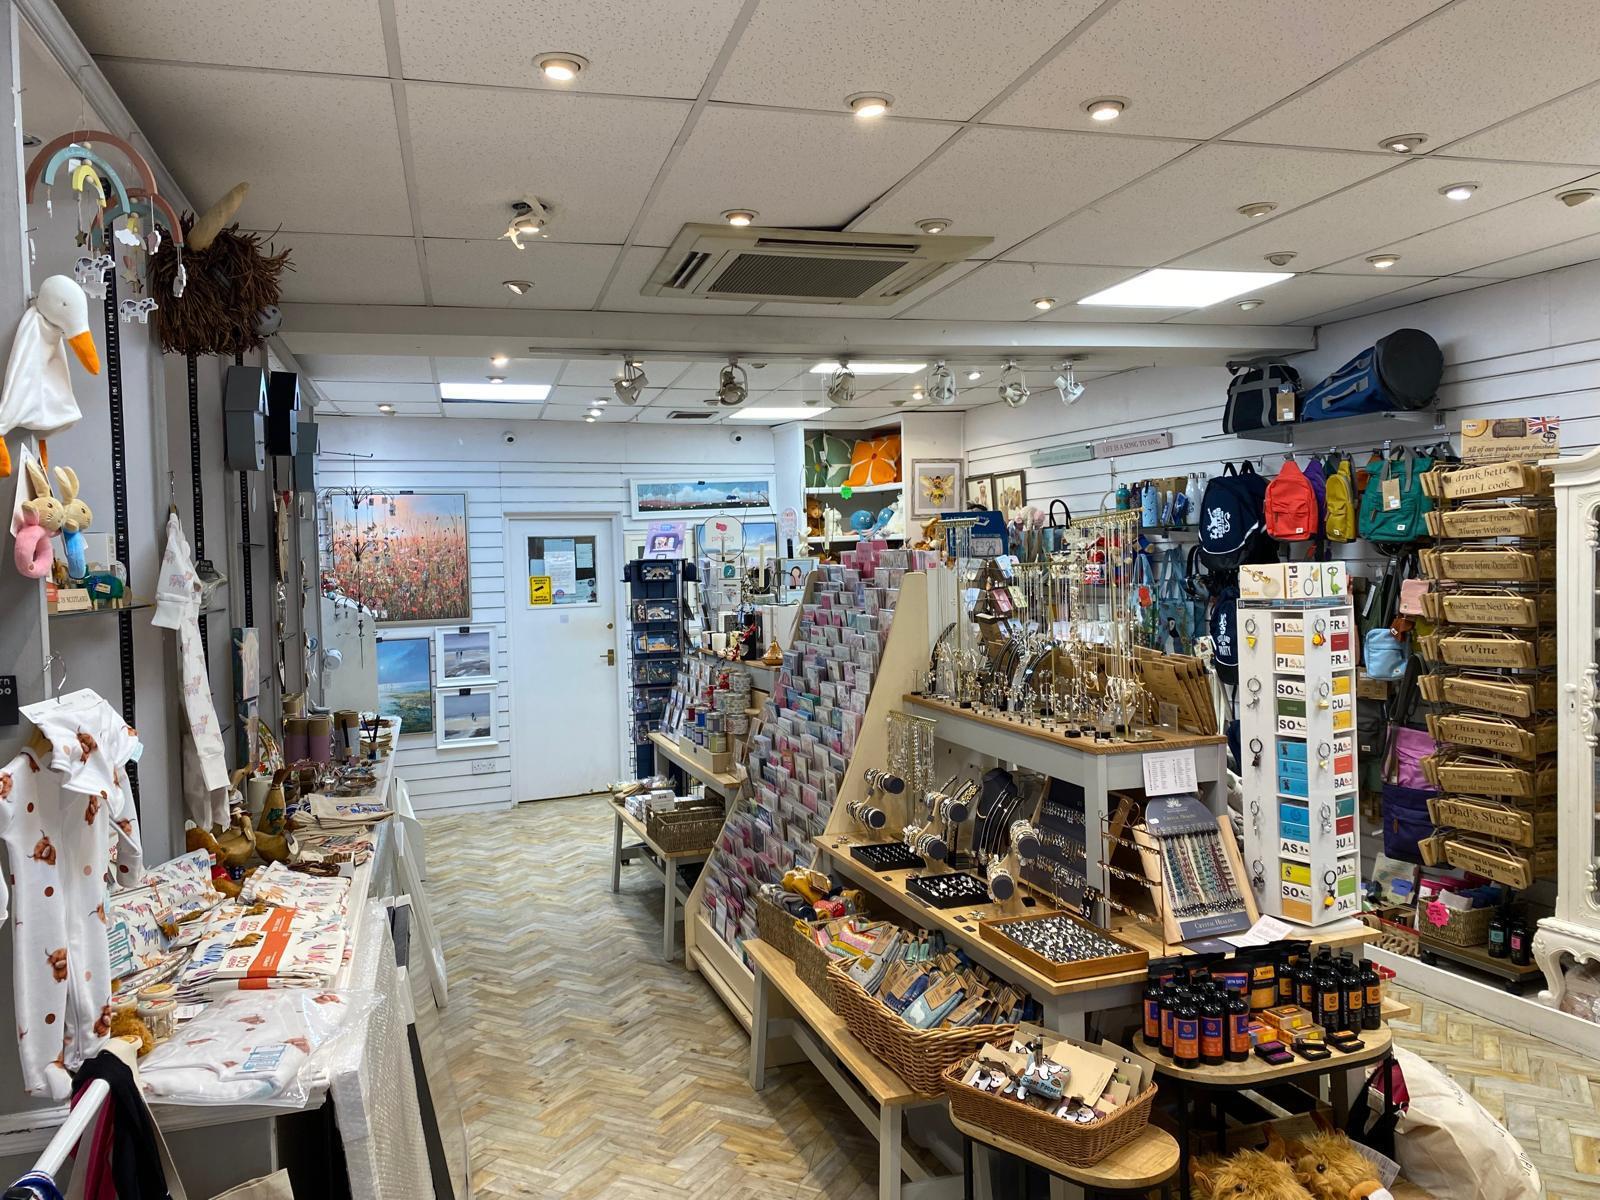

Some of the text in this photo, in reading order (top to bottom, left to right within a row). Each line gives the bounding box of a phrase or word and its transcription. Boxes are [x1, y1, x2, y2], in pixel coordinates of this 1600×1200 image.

[1124, 441, 1139, 451] SONG
[1140, 440, 1148, 448] TO
[1495, 443, 1521, 453] products
[1531, 443, 1554, 451] finished
[1455, 469, 1480, 483] drink
[1455, 485, 1477, 496] than
[1488, 479, 1511, 491] cook
[1458, 526, 1511, 537] Always Welcome
[1471, 601, 1486, 611] Than
[1487, 601, 1501, 611] Next
[1274, 622, 1286, 633] PI
[1330, 620, 1340, 630] FR
[1463, 644, 1498, 655] Wine
[1276, 657, 1289, 668] PI
[1331, 654, 1342, 665] FR
[1277, 684, 1294, 695] SO
[1279, 719, 1296, 730] SO
[1454, 723, 1475, 733] This
[1489, 729, 1506, 737] my
[1450, 733, 1517, 749] Happy Place
[1448, 804, 1479, 821] Dad's
[1480, 811, 1510, 826] Shed
[1281, 842, 1298, 855] AS
[1473, 863, 1494, 878] Dog
[1282, 885, 1299, 898] SO
[1337, 899, 1349, 911] DA
[236, 955, 251, 968] COO
